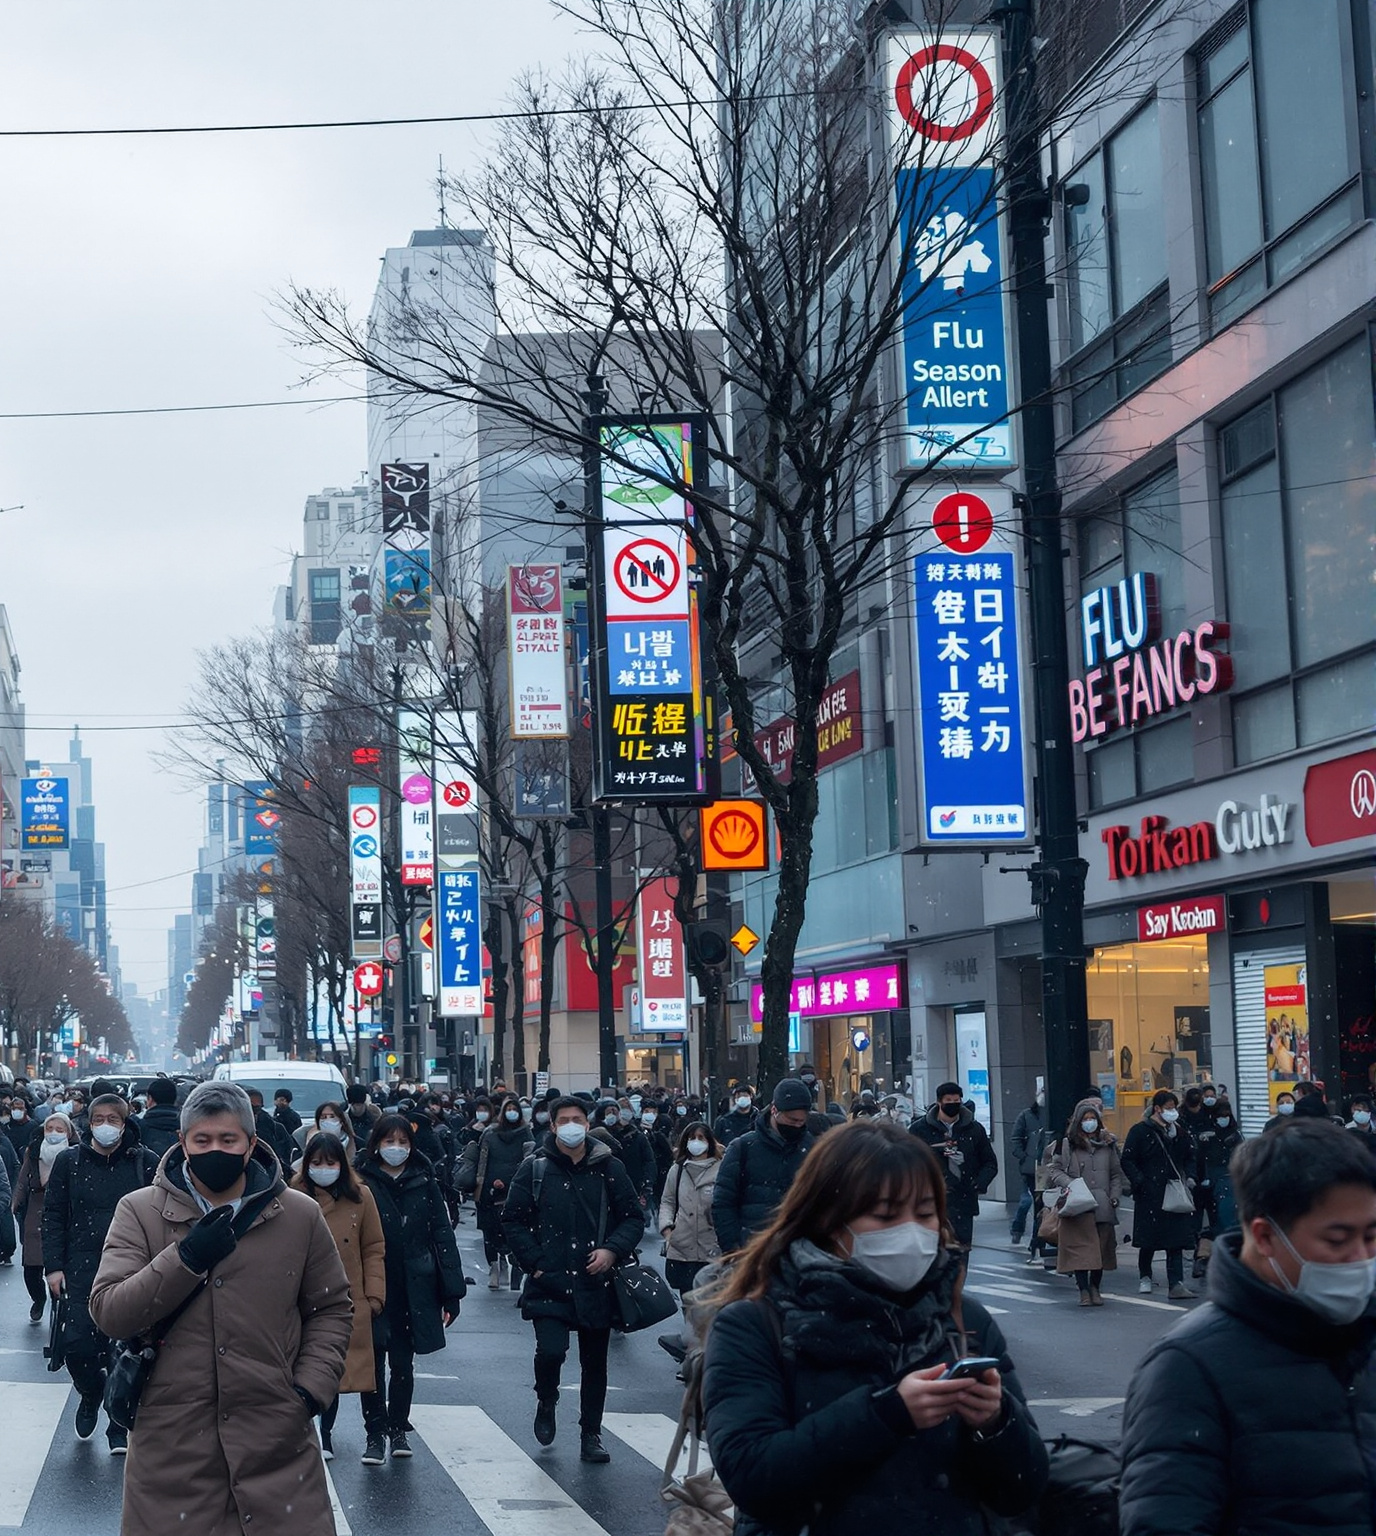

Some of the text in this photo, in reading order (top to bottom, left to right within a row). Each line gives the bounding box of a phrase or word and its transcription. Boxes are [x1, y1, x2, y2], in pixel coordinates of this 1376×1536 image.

[933, 321, 984, 349] Flu
[913, 359, 1002, 382] Season
[922, 386, 989, 408] Allert
[1082, 572, 1148, 667] FLU
[1068, 668, 1106, 743] BE
[1113, 620, 1218, 726] FANCS
[1145, 909, 1169, 938] Say
